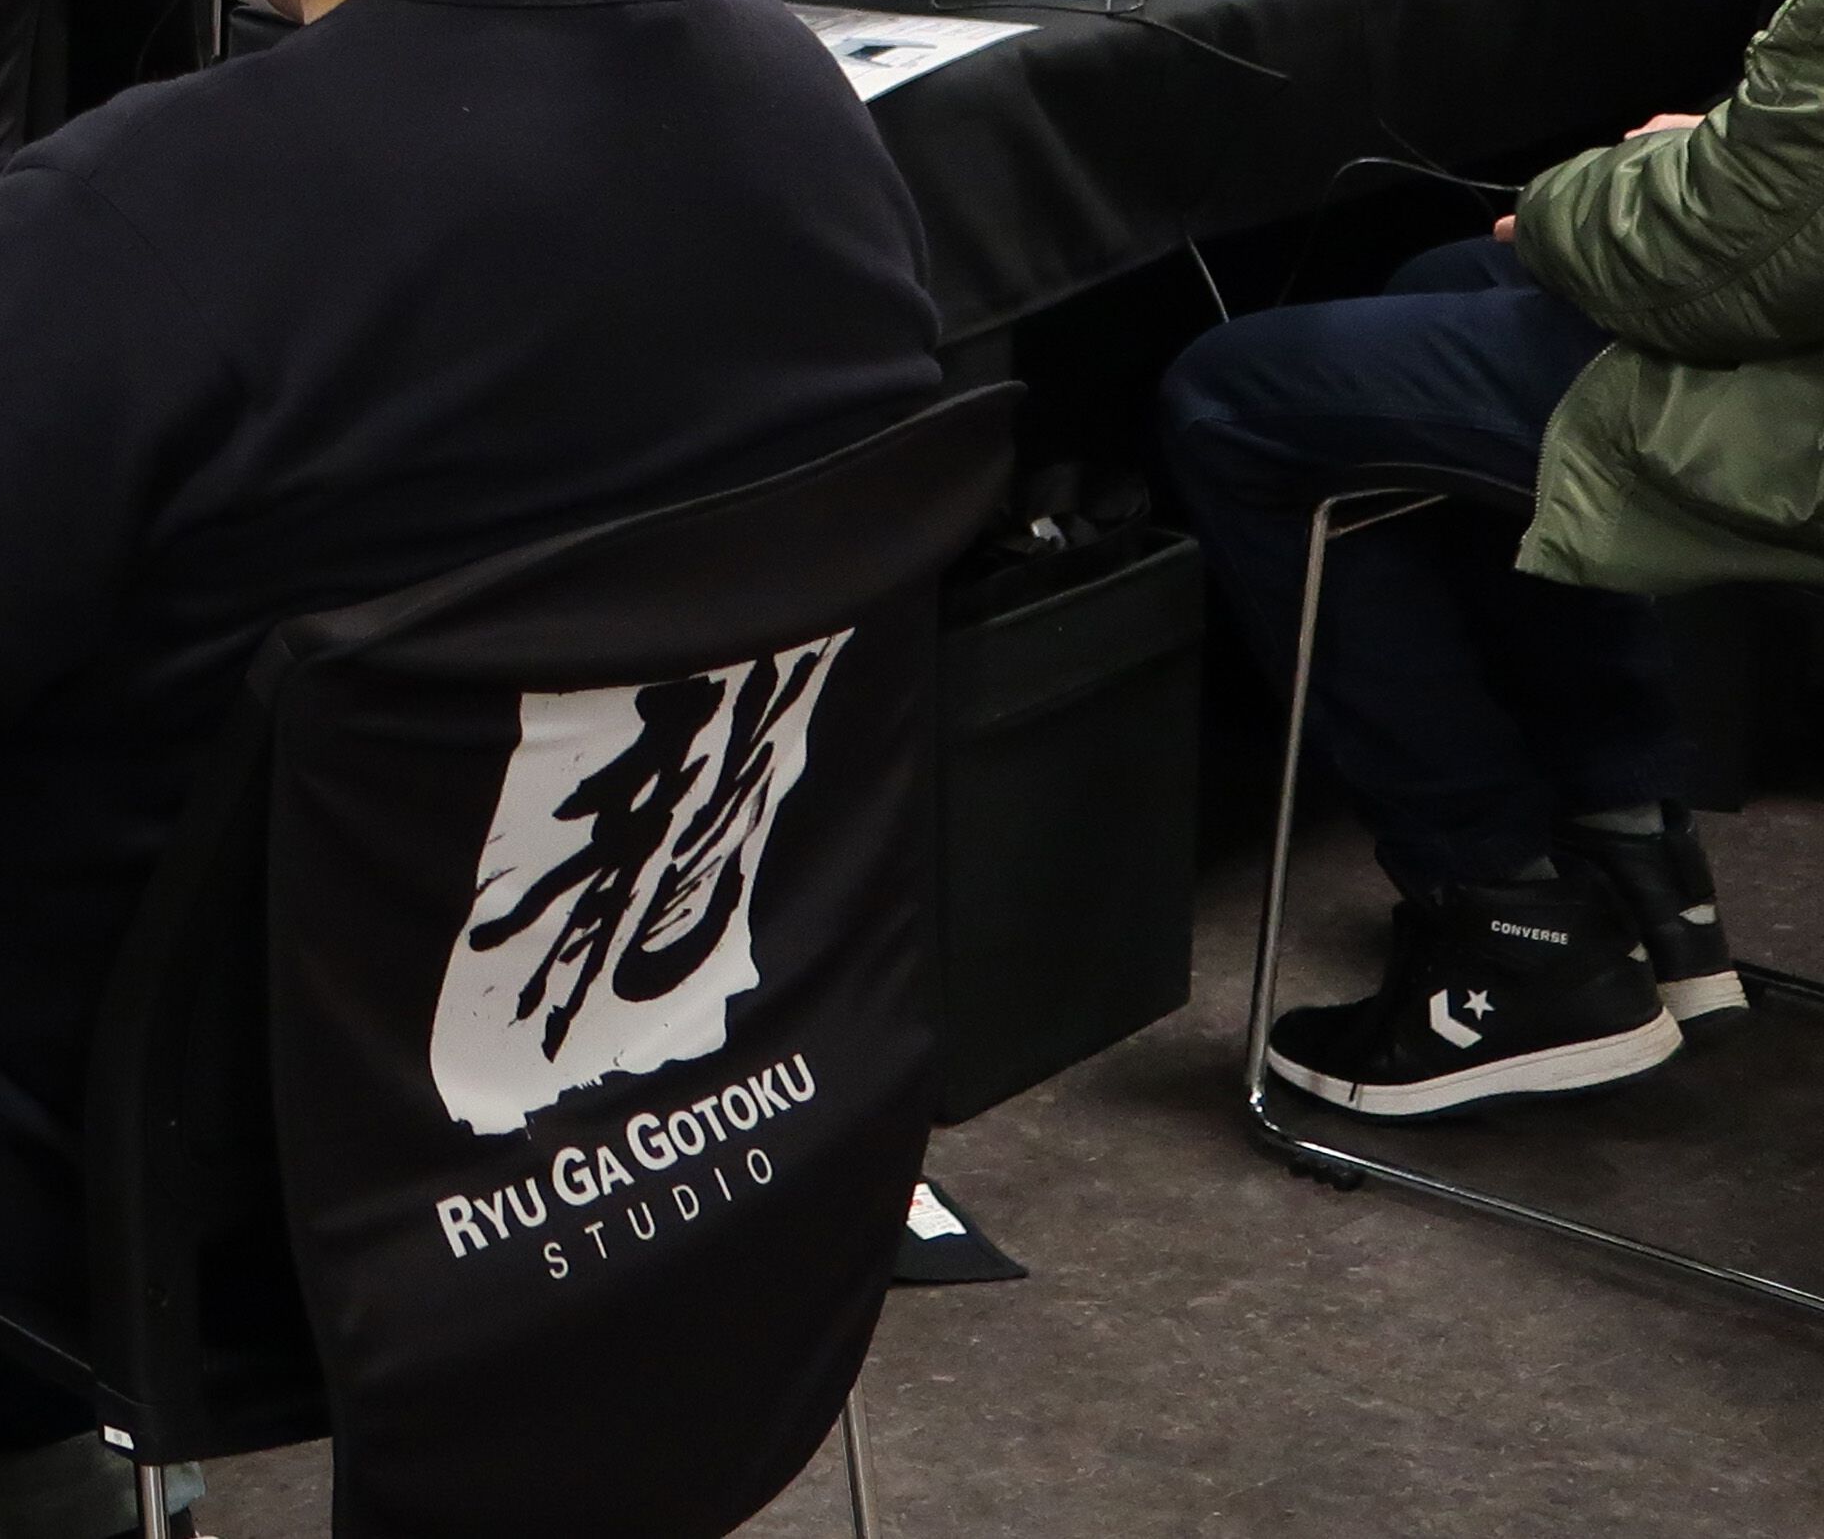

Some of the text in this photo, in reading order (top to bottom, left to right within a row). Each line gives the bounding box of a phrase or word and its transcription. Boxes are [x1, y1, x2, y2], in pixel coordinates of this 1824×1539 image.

[469, 637, 833, 1063] 龍
[1490, 920, 1569, 945] CONVERSE
[436, 1053, 817, 1259] RYU GA GOTOKU
[544, 1148, 774, 1279] STUDIO
